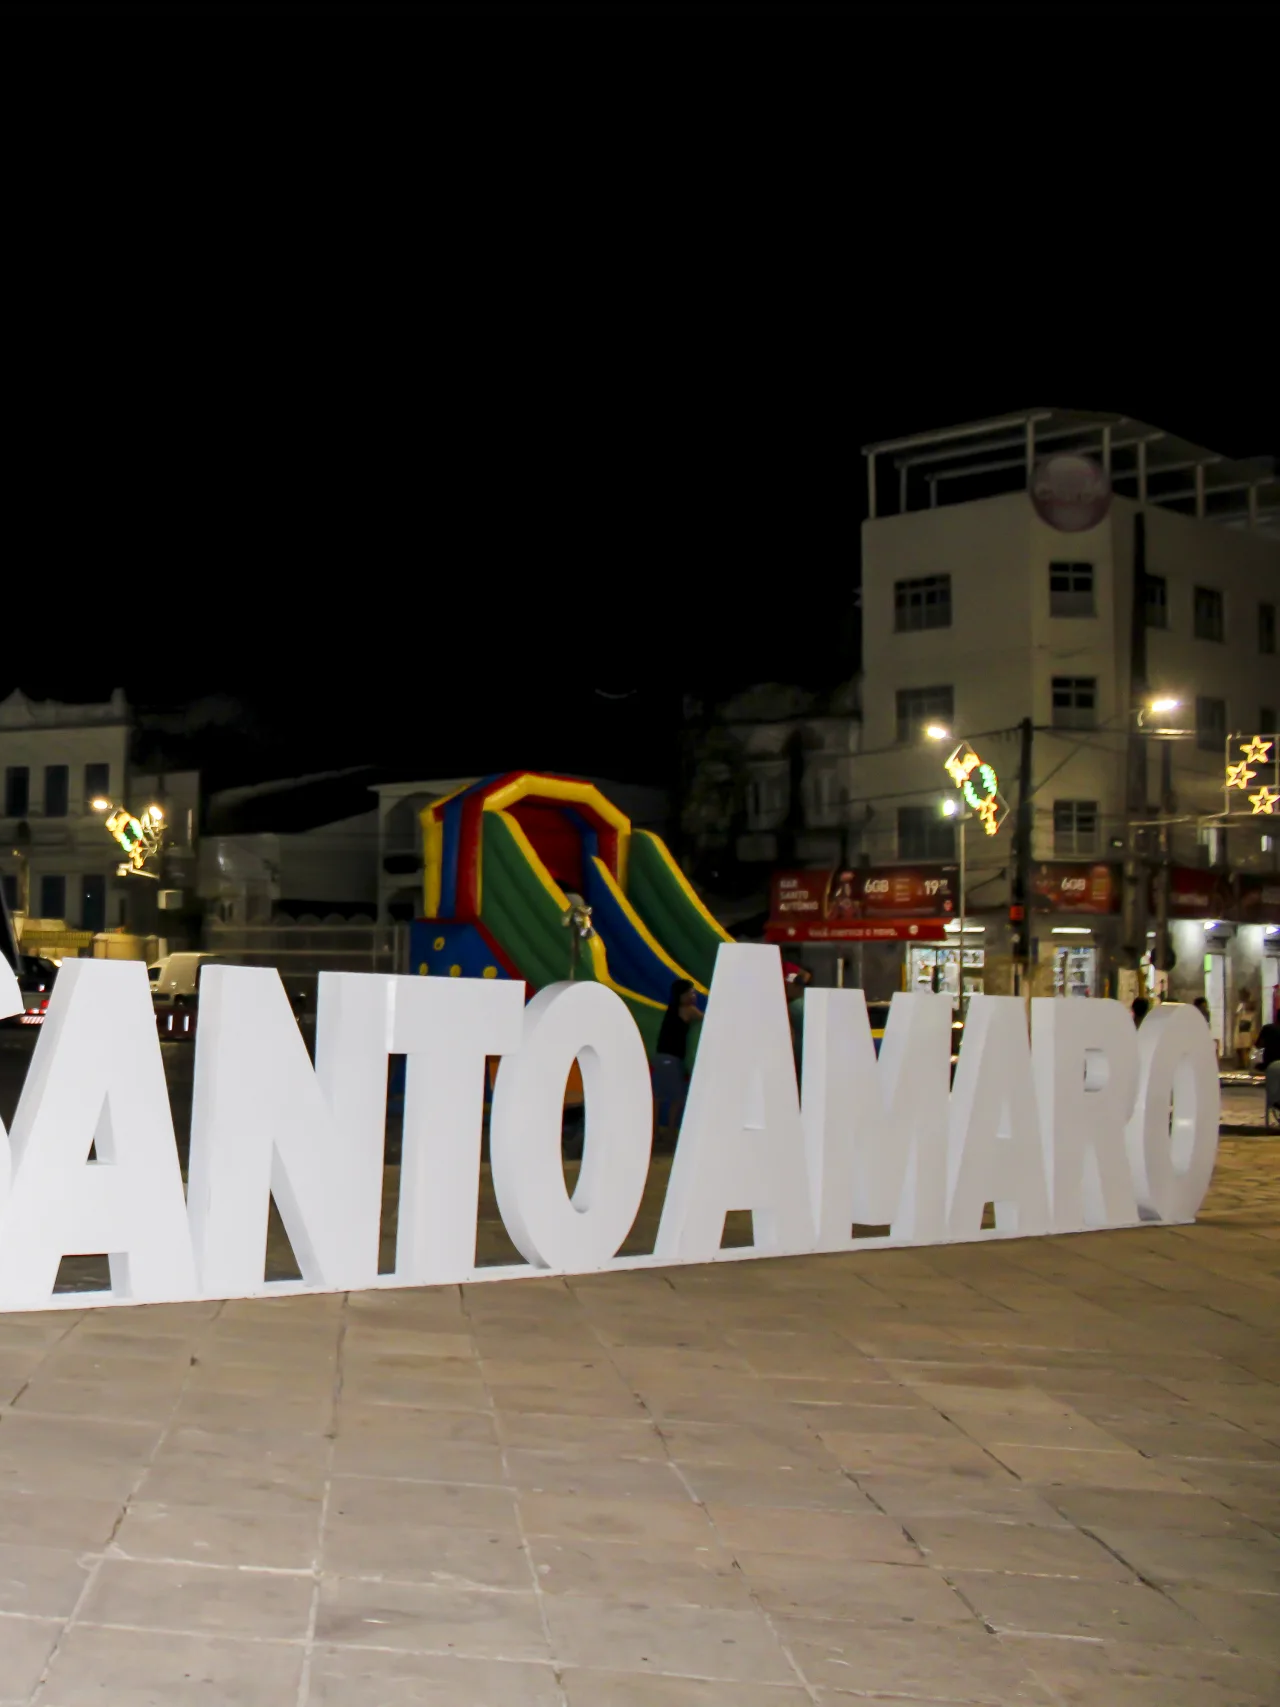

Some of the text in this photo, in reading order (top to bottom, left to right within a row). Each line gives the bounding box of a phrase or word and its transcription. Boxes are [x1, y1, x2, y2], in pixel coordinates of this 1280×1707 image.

[864, 878, 889, 894] 6GB
[1061, 877, 1086, 891] 6GB
[780, 890, 809, 901] SANTO
[653, 943, 1220, 1268] AMARO
